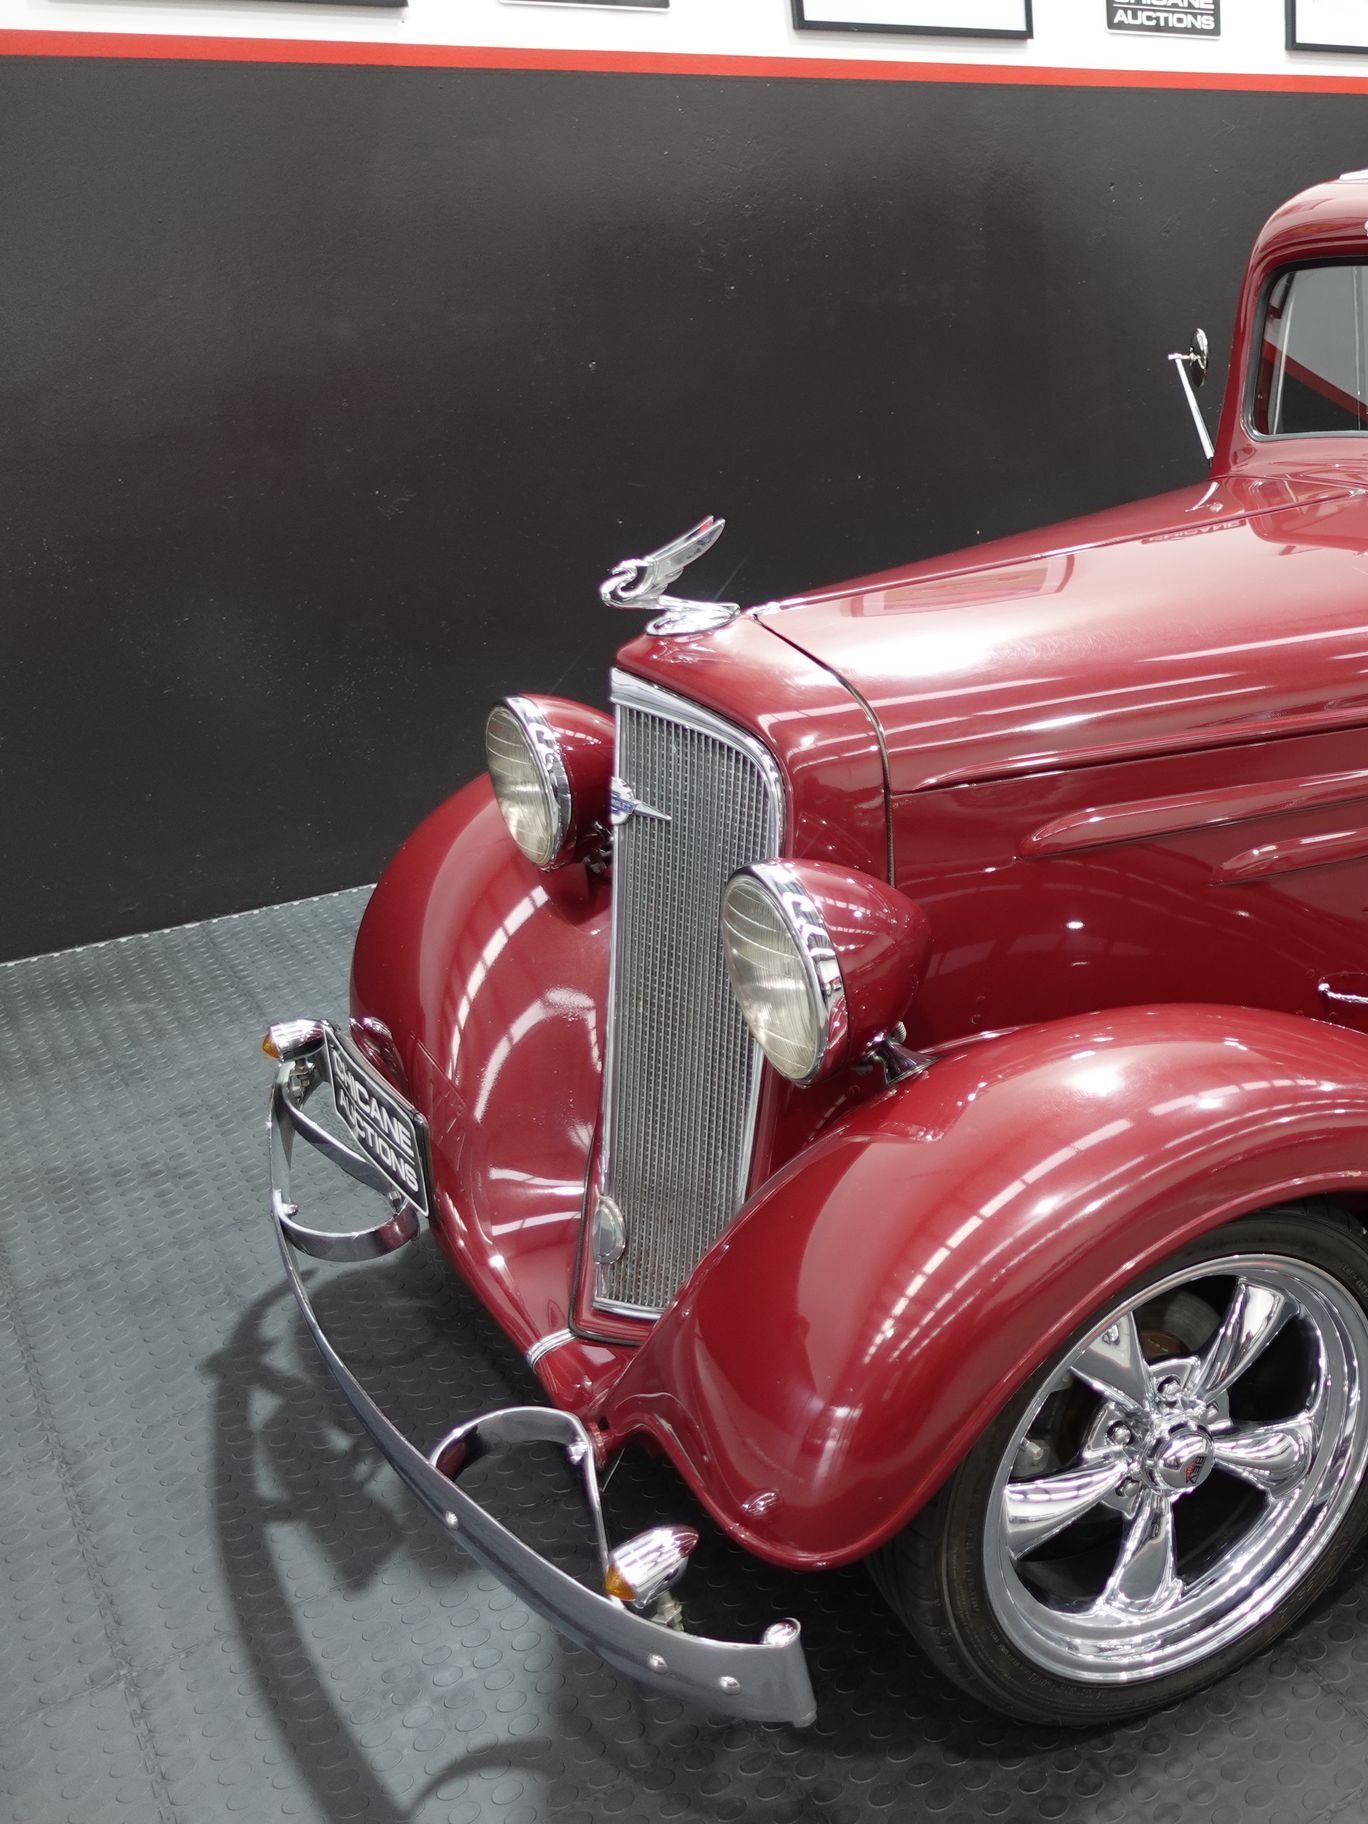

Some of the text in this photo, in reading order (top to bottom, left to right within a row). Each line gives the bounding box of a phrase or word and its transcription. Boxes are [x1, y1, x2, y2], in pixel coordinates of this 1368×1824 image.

[1113, 9, 1215, 30] AUCTIONS
[332, 1050, 416, 1158] CHICANE
[339, 1089, 420, 1192] AUCTIONS
